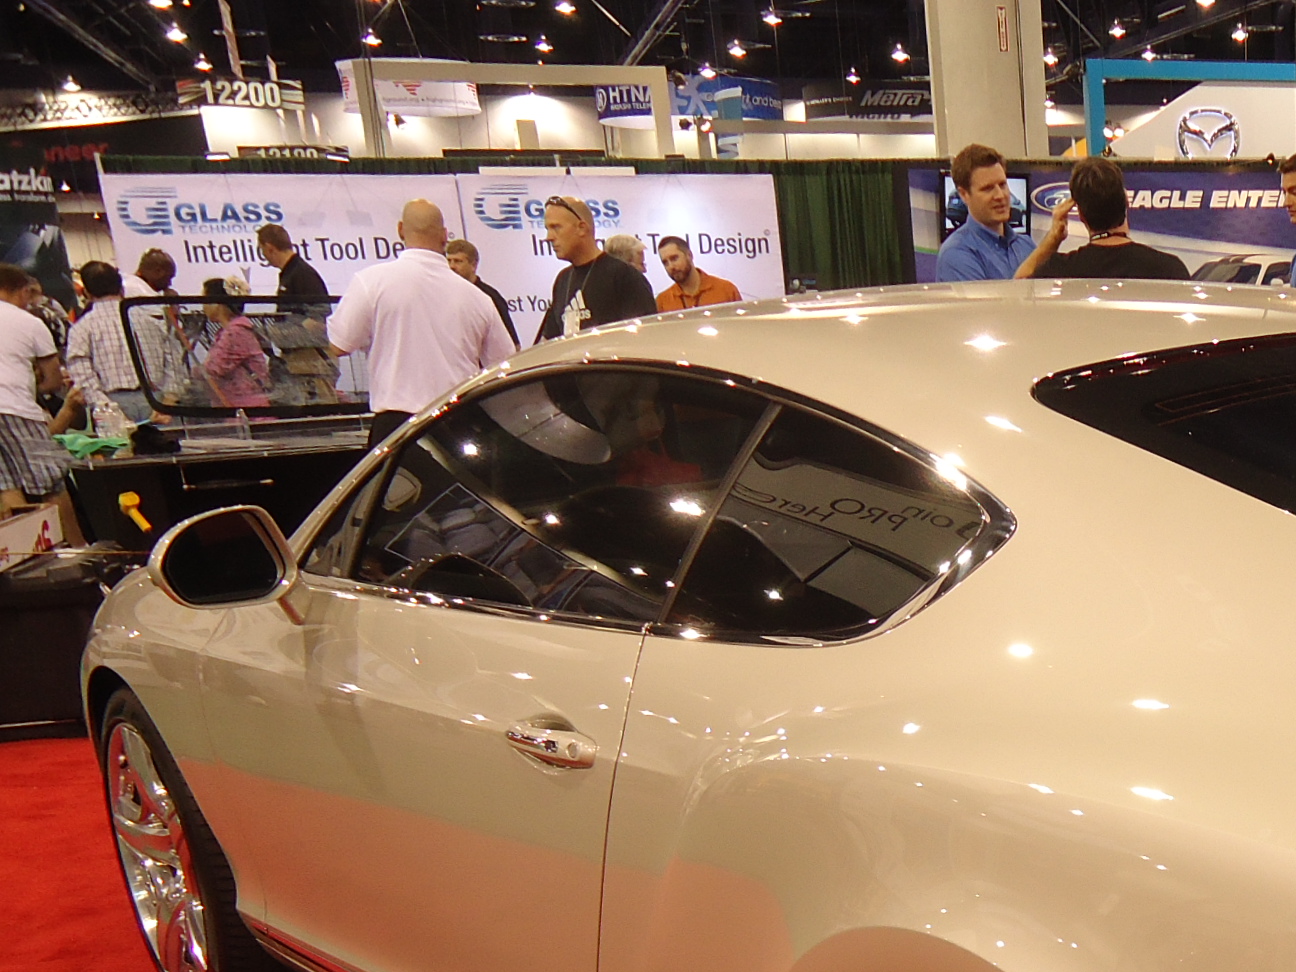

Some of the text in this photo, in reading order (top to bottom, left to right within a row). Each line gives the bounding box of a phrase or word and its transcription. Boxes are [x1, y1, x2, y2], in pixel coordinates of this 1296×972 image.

[200, 80, 282, 107] 12200
[524, 200, 620, 219] GSS
[1127, 190, 1204, 208] EAGLE
[174, 202, 284, 224] GLASS
[315, 236, 366, 260] Tool
[698, 232, 769, 260] Design
